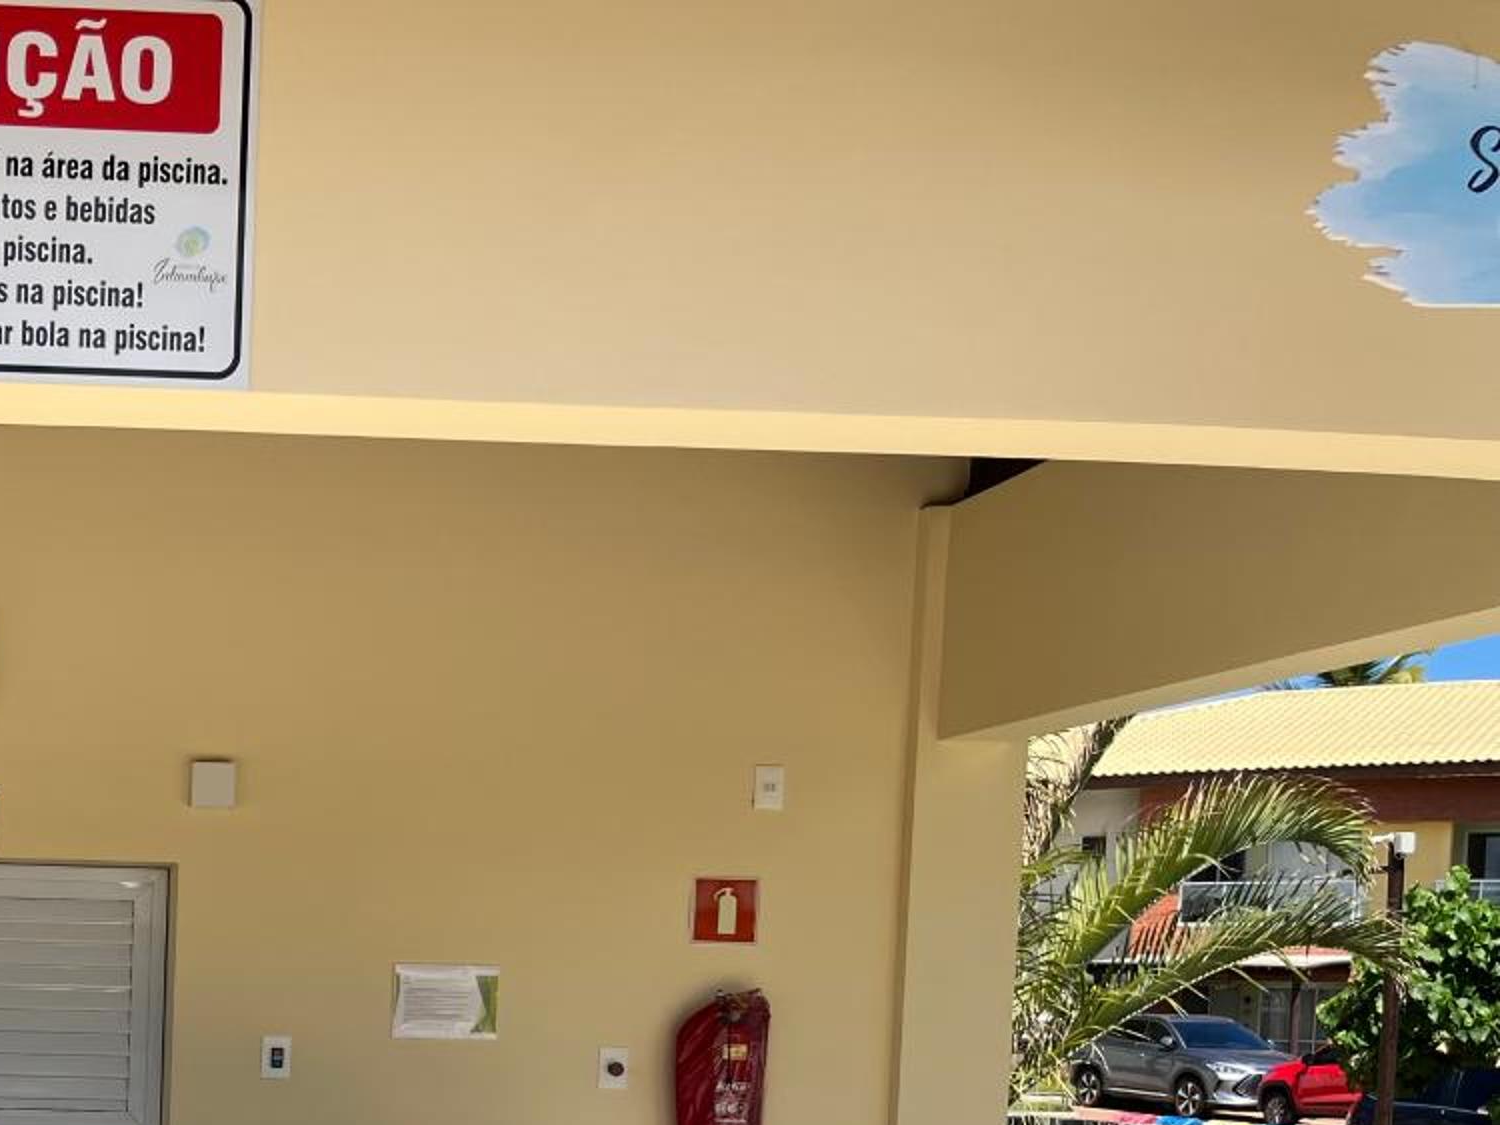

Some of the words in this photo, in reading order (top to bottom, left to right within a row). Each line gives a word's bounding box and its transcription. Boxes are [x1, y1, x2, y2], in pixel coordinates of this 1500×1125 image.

[5, 155, 34, 178] na
[41, 151, 94, 180] área
[101, 154, 130, 182] da
[138, 157, 228, 189] piscina.
[44, 200, 57, 221] e
[65, 195, 155, 225] bebidas
[3, 235, 93, 267] piscina.
[16, 283, 43, 305] na
[53, 279, 143, 311] piscina!
[21, 319, 69, 347] bola
[79, 328, 106, 349] na
[115, 323, 205, 355] piscina!
